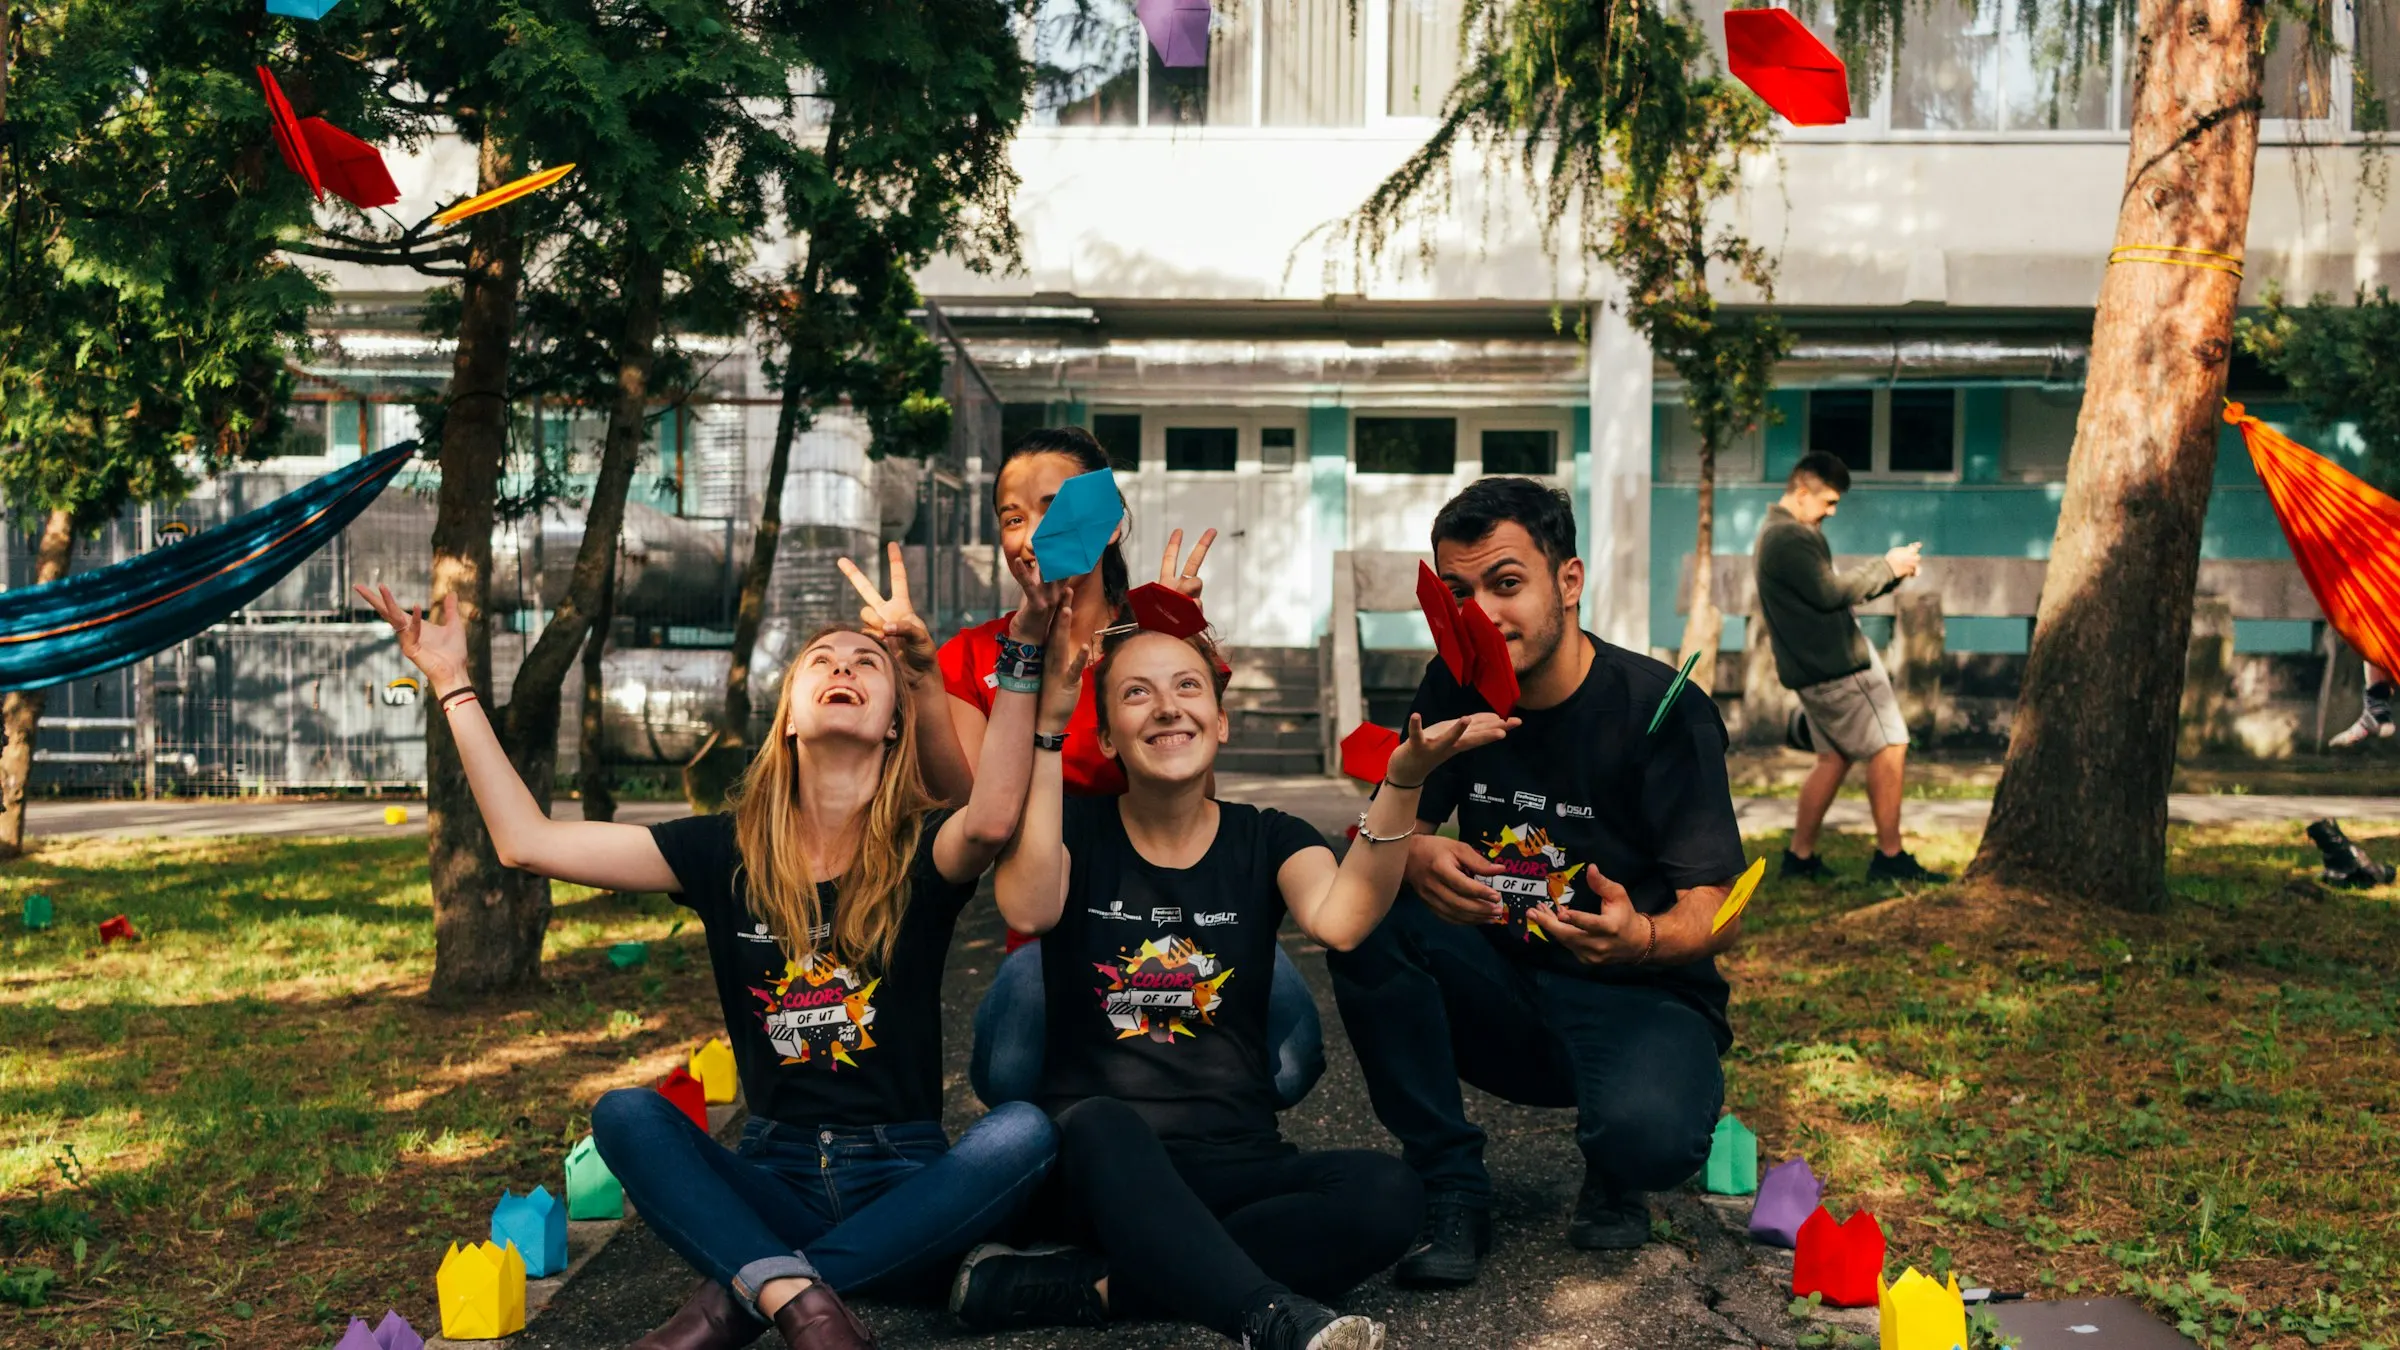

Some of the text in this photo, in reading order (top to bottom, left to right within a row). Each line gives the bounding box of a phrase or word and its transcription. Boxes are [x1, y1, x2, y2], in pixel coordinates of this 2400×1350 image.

[384, 687, 415, 705] VTS
[1494, 857, 1549, 877] COLORS
[1502, 880, 1537, 892] OF UT
[1205, 912, 1237, 923] OSUT
[1131, 971, 1195, 988] COLORS
[783, 987, 844, 1008] COLORS
[1142, 994, 1182, 1004] OF UT
[797, 1010, 836, 1024] OF UT
[838, 1025, 856, 1034] 2-27
[839, 1033, 856, 1042] MAI
